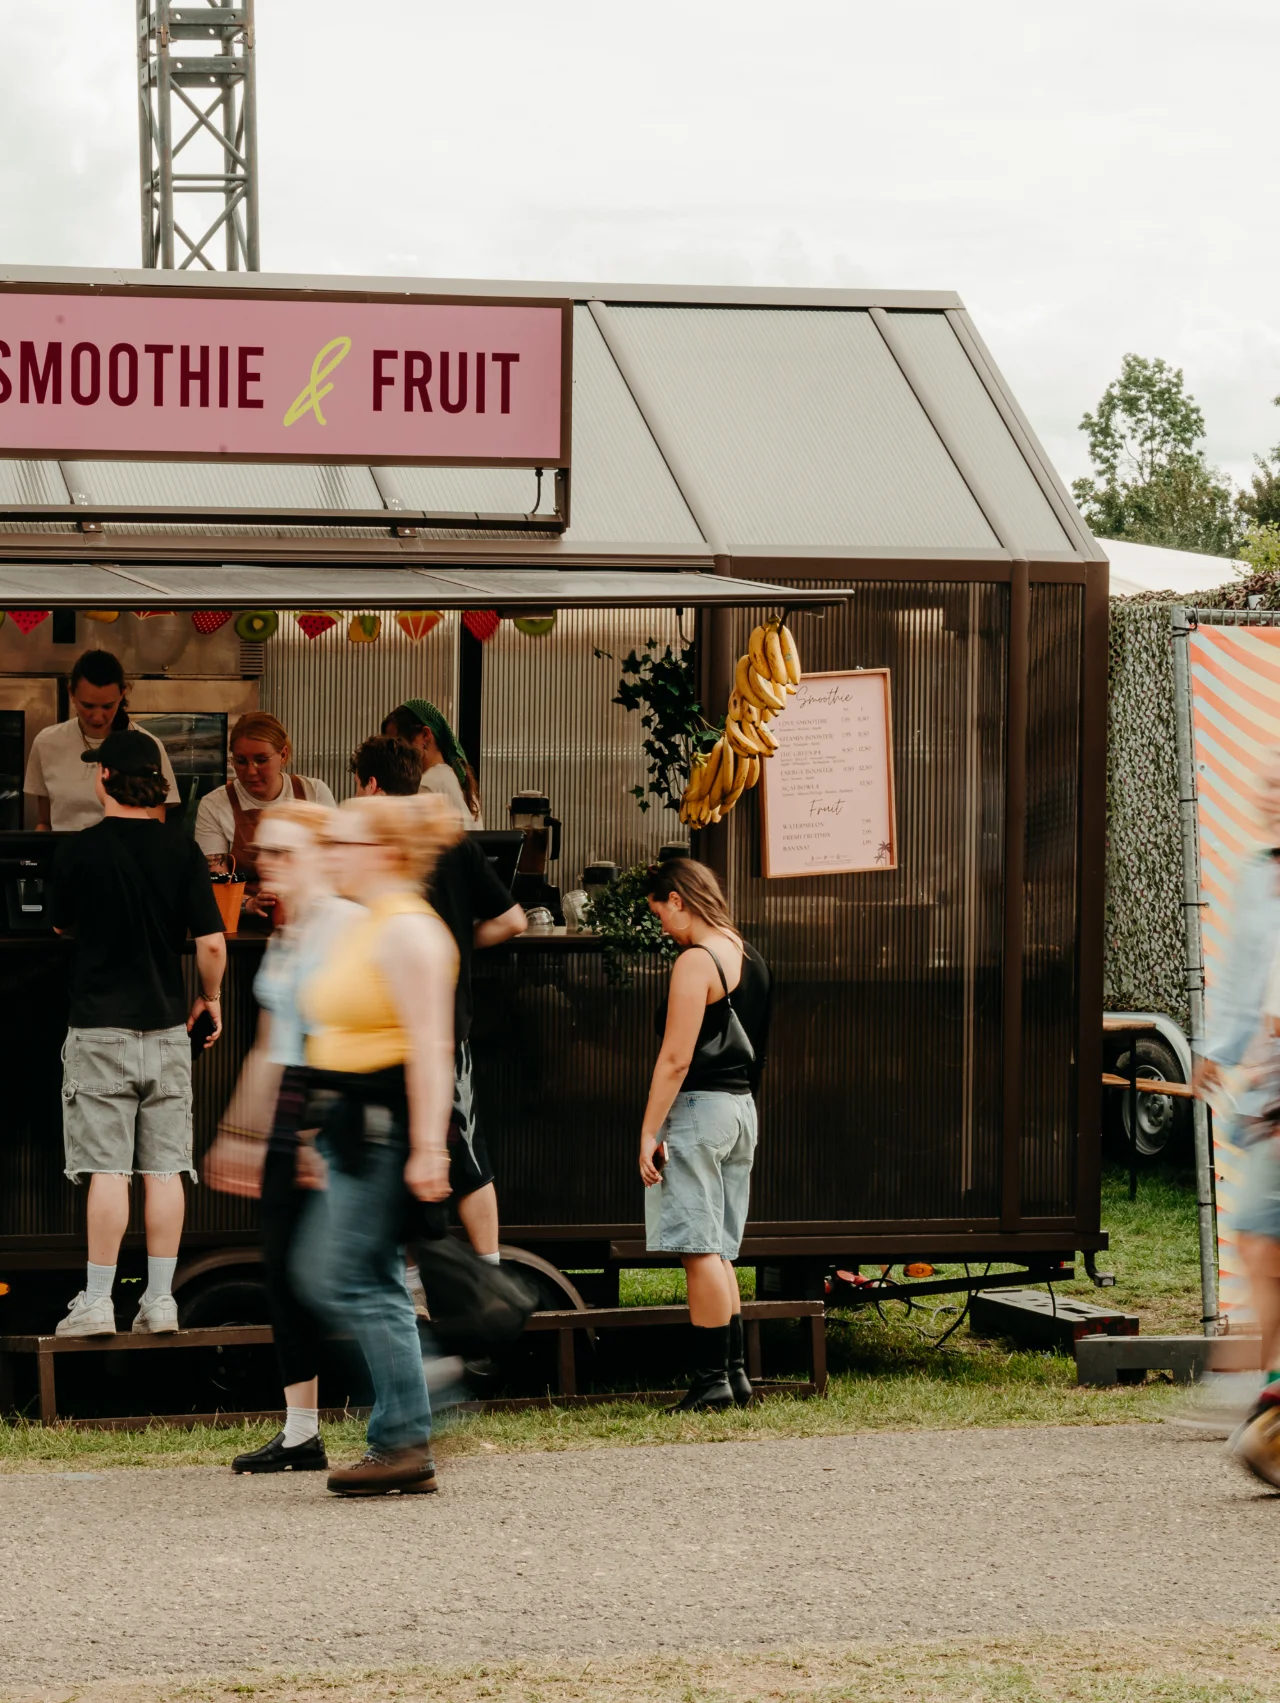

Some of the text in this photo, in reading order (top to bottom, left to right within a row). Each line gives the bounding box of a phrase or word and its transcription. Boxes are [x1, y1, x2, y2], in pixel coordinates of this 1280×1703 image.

[283, 335, 352, 427] &
[372, 349, 521, 415] FRUIT
[795, 685, 854, 709] Smoothie
[805, 767, 834, 775] BOOSTER
[809, 798, 846, 817] Fruit
[782, 821, 825, 830] WATERMELON
[782, 833, 802, 841] FRESH
